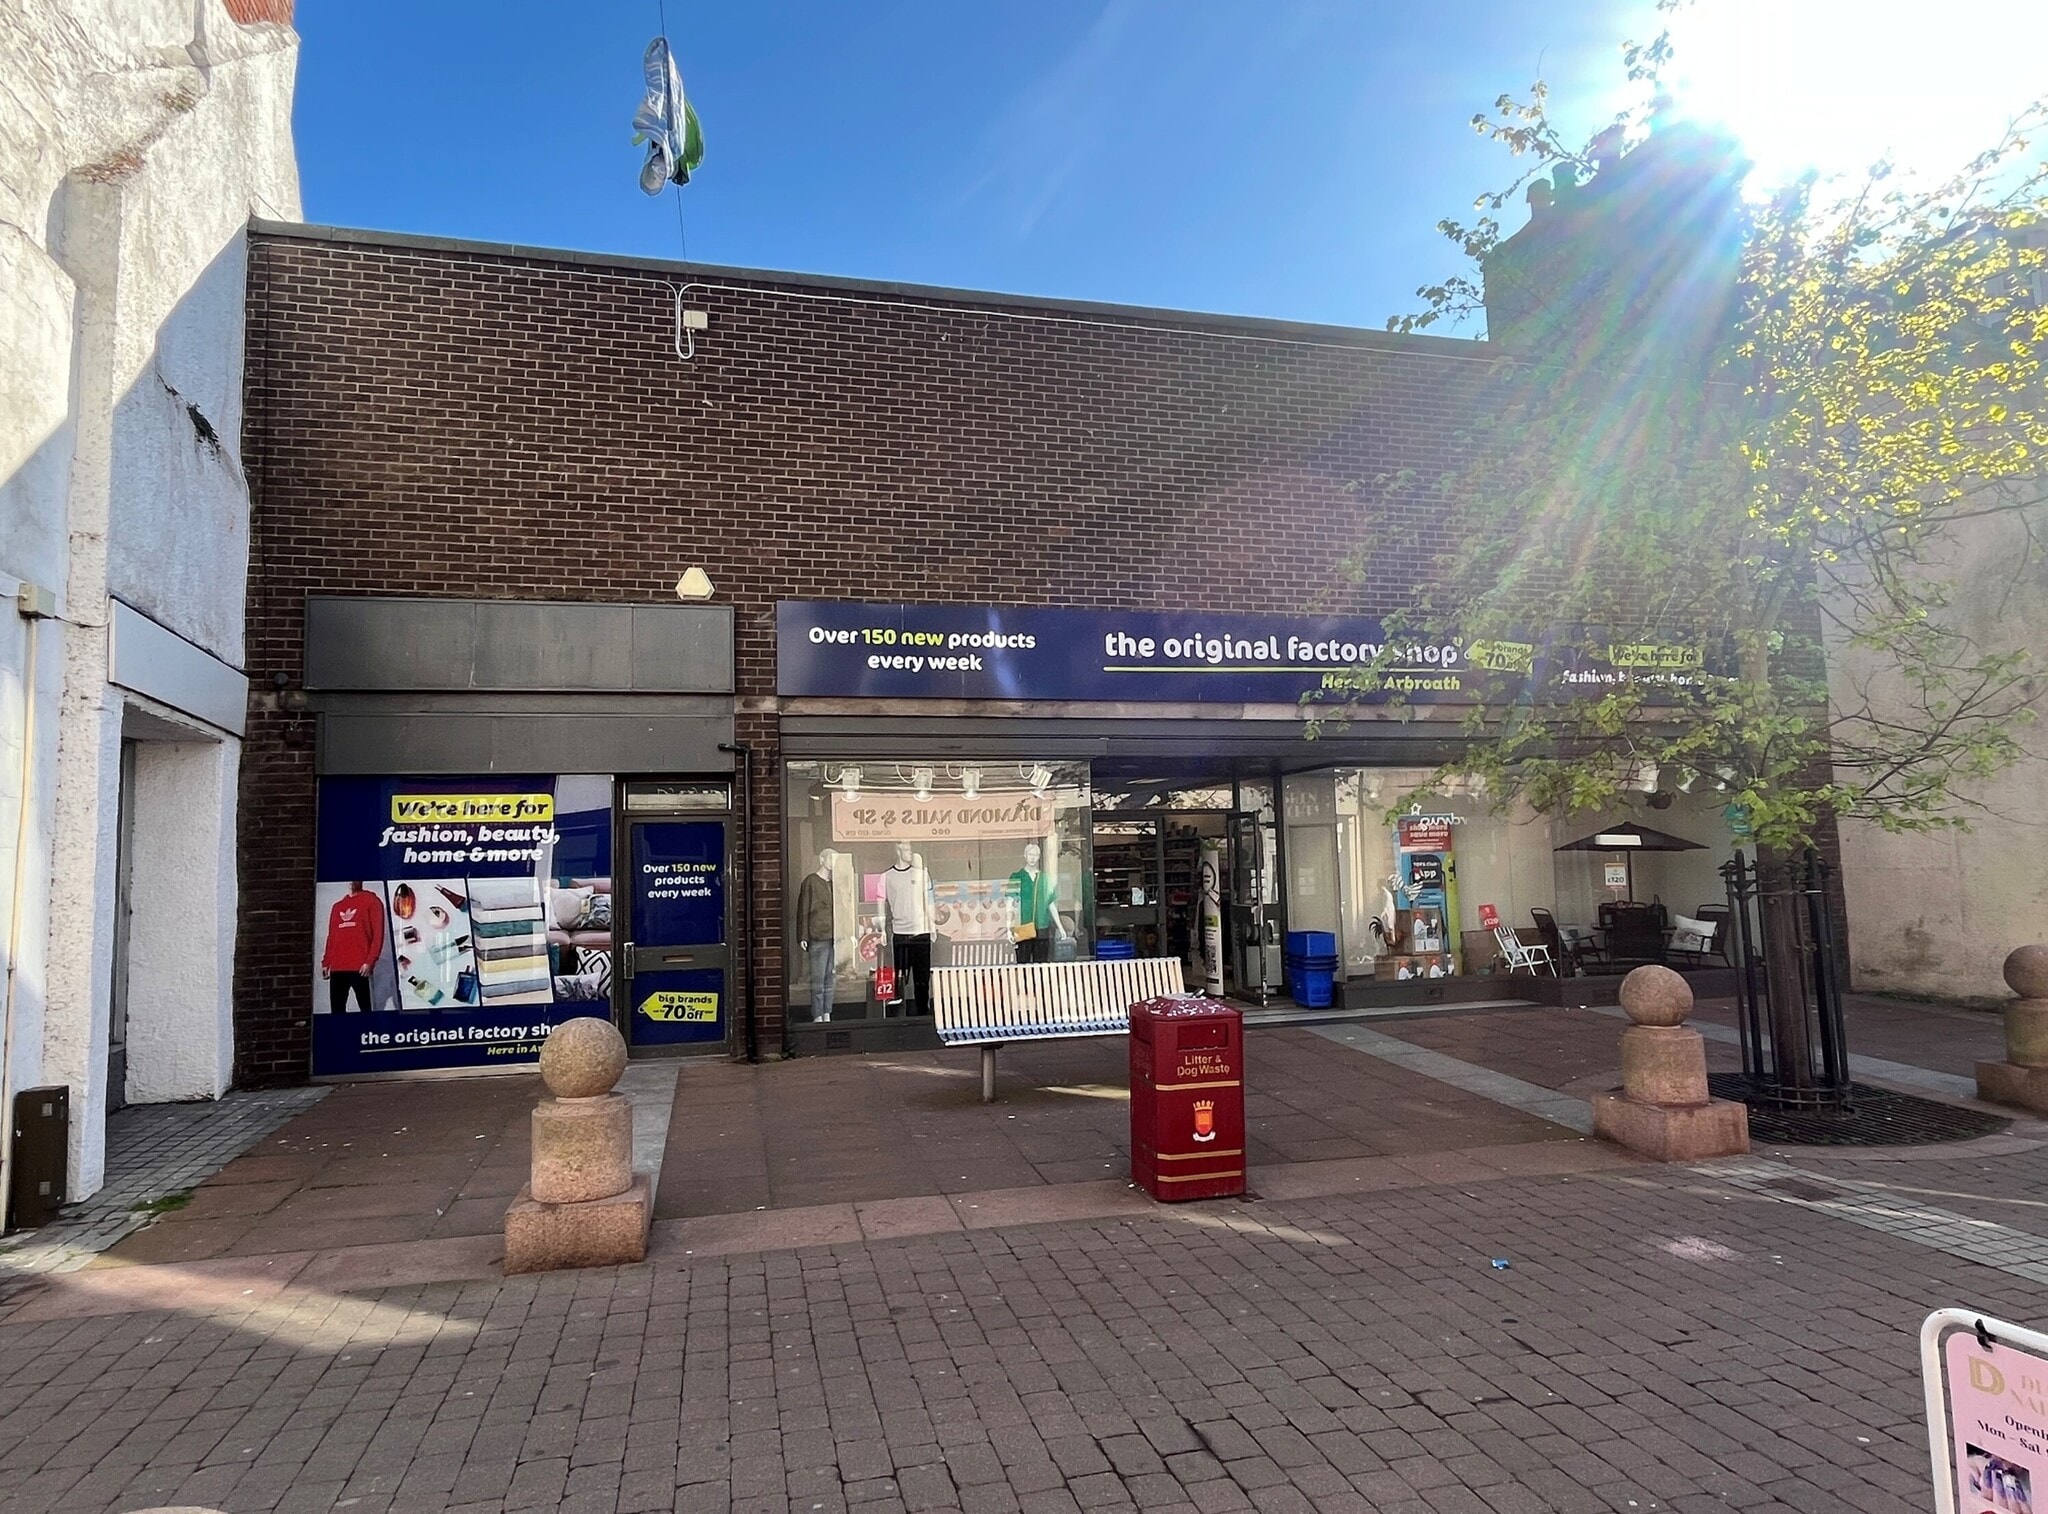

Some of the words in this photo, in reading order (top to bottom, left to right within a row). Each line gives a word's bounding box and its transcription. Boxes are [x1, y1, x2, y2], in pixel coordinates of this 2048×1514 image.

[808, 627, 859, 644] Over
[861, 629, 897, 645] 150
[901, 631, 944, 646] new
[947, 631, 1036, 650] products
[1105, 632, 1156, 658] the
[1163, 633, 1281, 664] original
[1287, 636, 1384, 667] factory
[867, 654, 924, 673] every
[928, 654, 983, 671] week
[1383, 675, 1460, 690] Arbroath
[397, 801, 457, 816] We're
[463, 801, 510, 816] here
[512, 800, 548, 818] for
[379, 825, 473, 847] fashion,
[478, 825, 561, 845] beauty,
[403, 847, 465, 863] home
[469, 847, 487, 862] &
[487, 849, 544, 862] more
[643, 863, 670, 874] Over
[671, 863, 690, 873] 150
[692, 864, 717, 873] new
[654, 875, 705, 887] products
[647, 889, 679, 900] every
[680, 886, 712, 897] week
[877, 983, 893, 995] £12
[658, 994, 675, 1004] big
[677, 995, 713, 1004] brands
[686, 1010, 704, 1020] off
[361, 1031, 391, 1046] the
[395, 1027, 465, 1045] original
[468, 1025, 528, 1040] factory
[487, 1046, 514, 1056] Here
[516, 1044, 528, 1054] in
[1185, 1055, 1212, 1065] Litter
[1215, 1054, 1222, 1063] &
[1177, 1066, 1198, 1077] Dog
[1199, 1064, 1230, 1074] Waste
[1968, 1355, 2006, 1396] D
[1977, 1418, 2006, 1440] Mon
